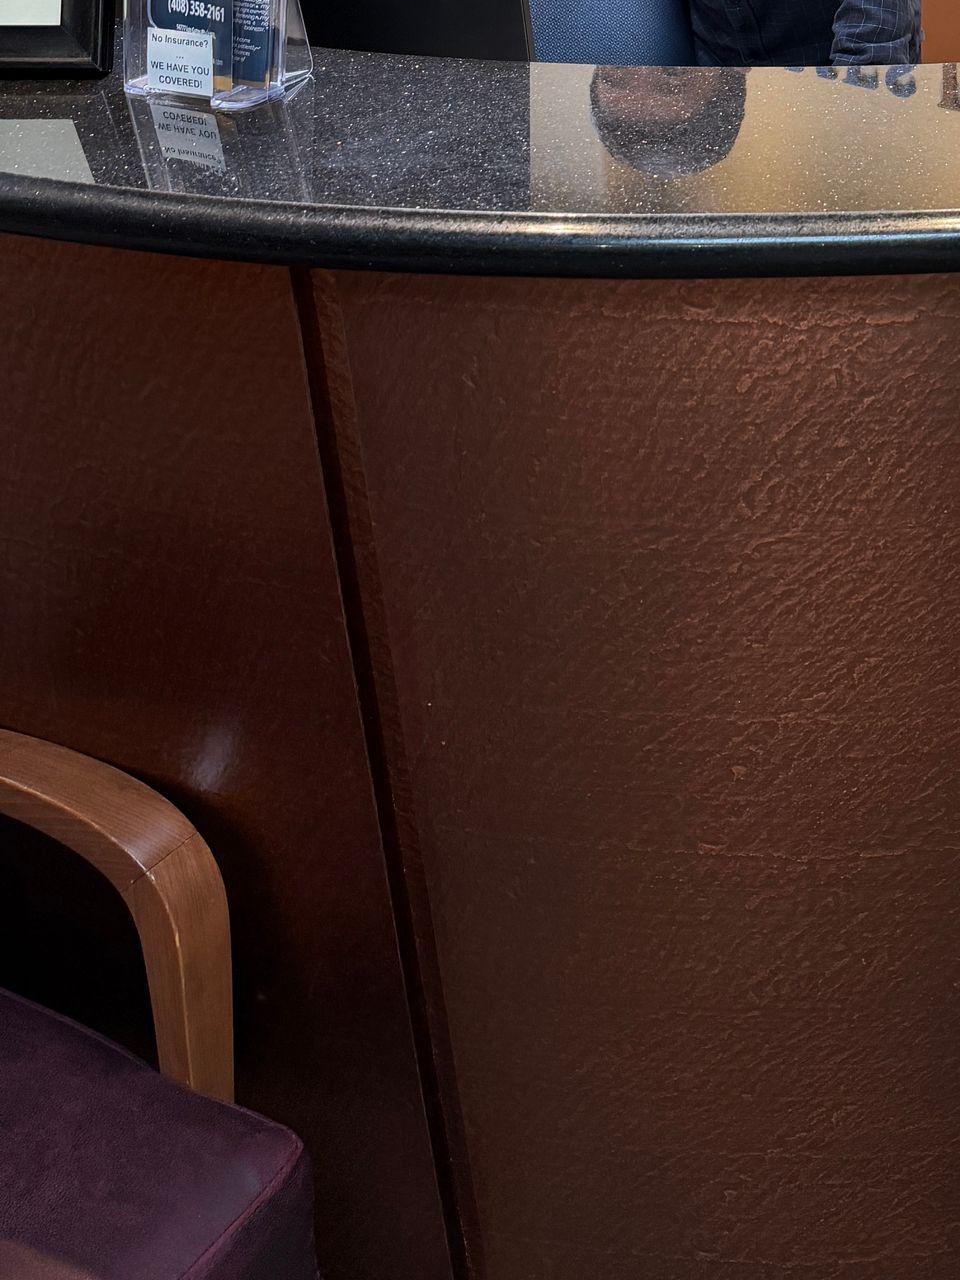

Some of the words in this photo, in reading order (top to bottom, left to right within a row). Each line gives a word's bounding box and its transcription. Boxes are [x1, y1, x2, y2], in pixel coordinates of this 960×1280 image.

[190, 0, 225, 23] 358-2161
[151, 33, 163, 43] No
[165, 35, 209, 48] Insurance?
[151, 60, 164, 70] WE
[166, 62, 189, 74] HAVE
[191, 65, 210, 76] YOU
[158, 75, 203, 89] COVERED!
